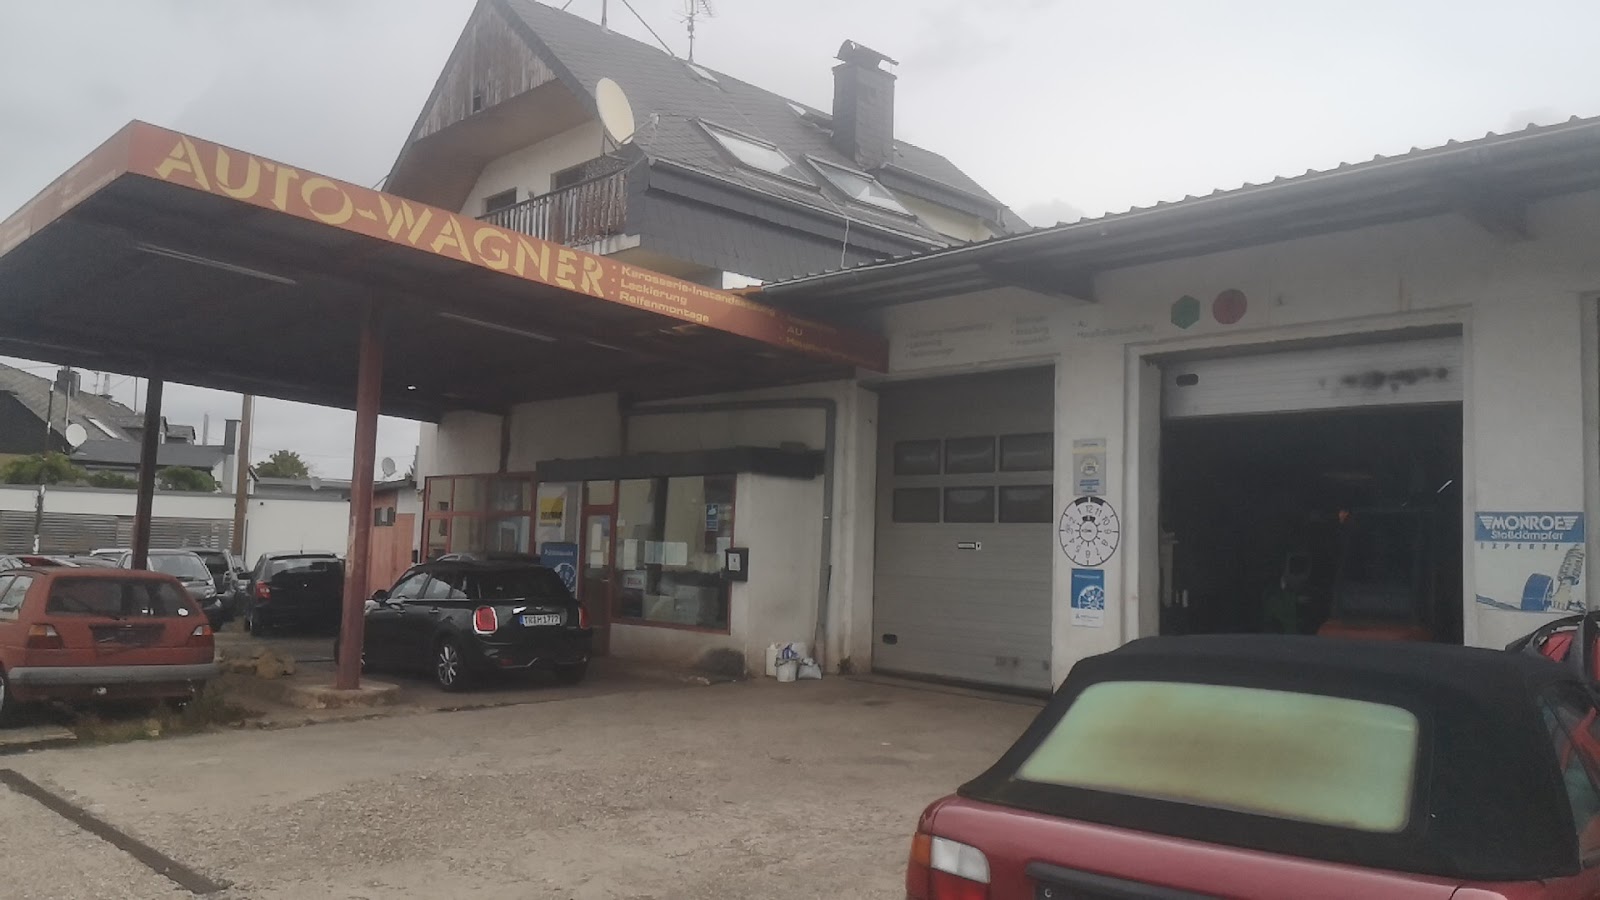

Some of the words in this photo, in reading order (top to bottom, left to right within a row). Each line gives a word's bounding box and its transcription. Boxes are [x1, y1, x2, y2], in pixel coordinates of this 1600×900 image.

[154, 134, 605, 298] AUTO-WAGNER
[620, 278, 688, 306] Lackierung
[621, 265, 776, 317] Karosserie-Instandsg
[619, 291, 709, 323] Reifenmontage
[1490, 530, 1564, 541] Stoßdämpfer
[1492, 515, 1566, 531] MONROE
